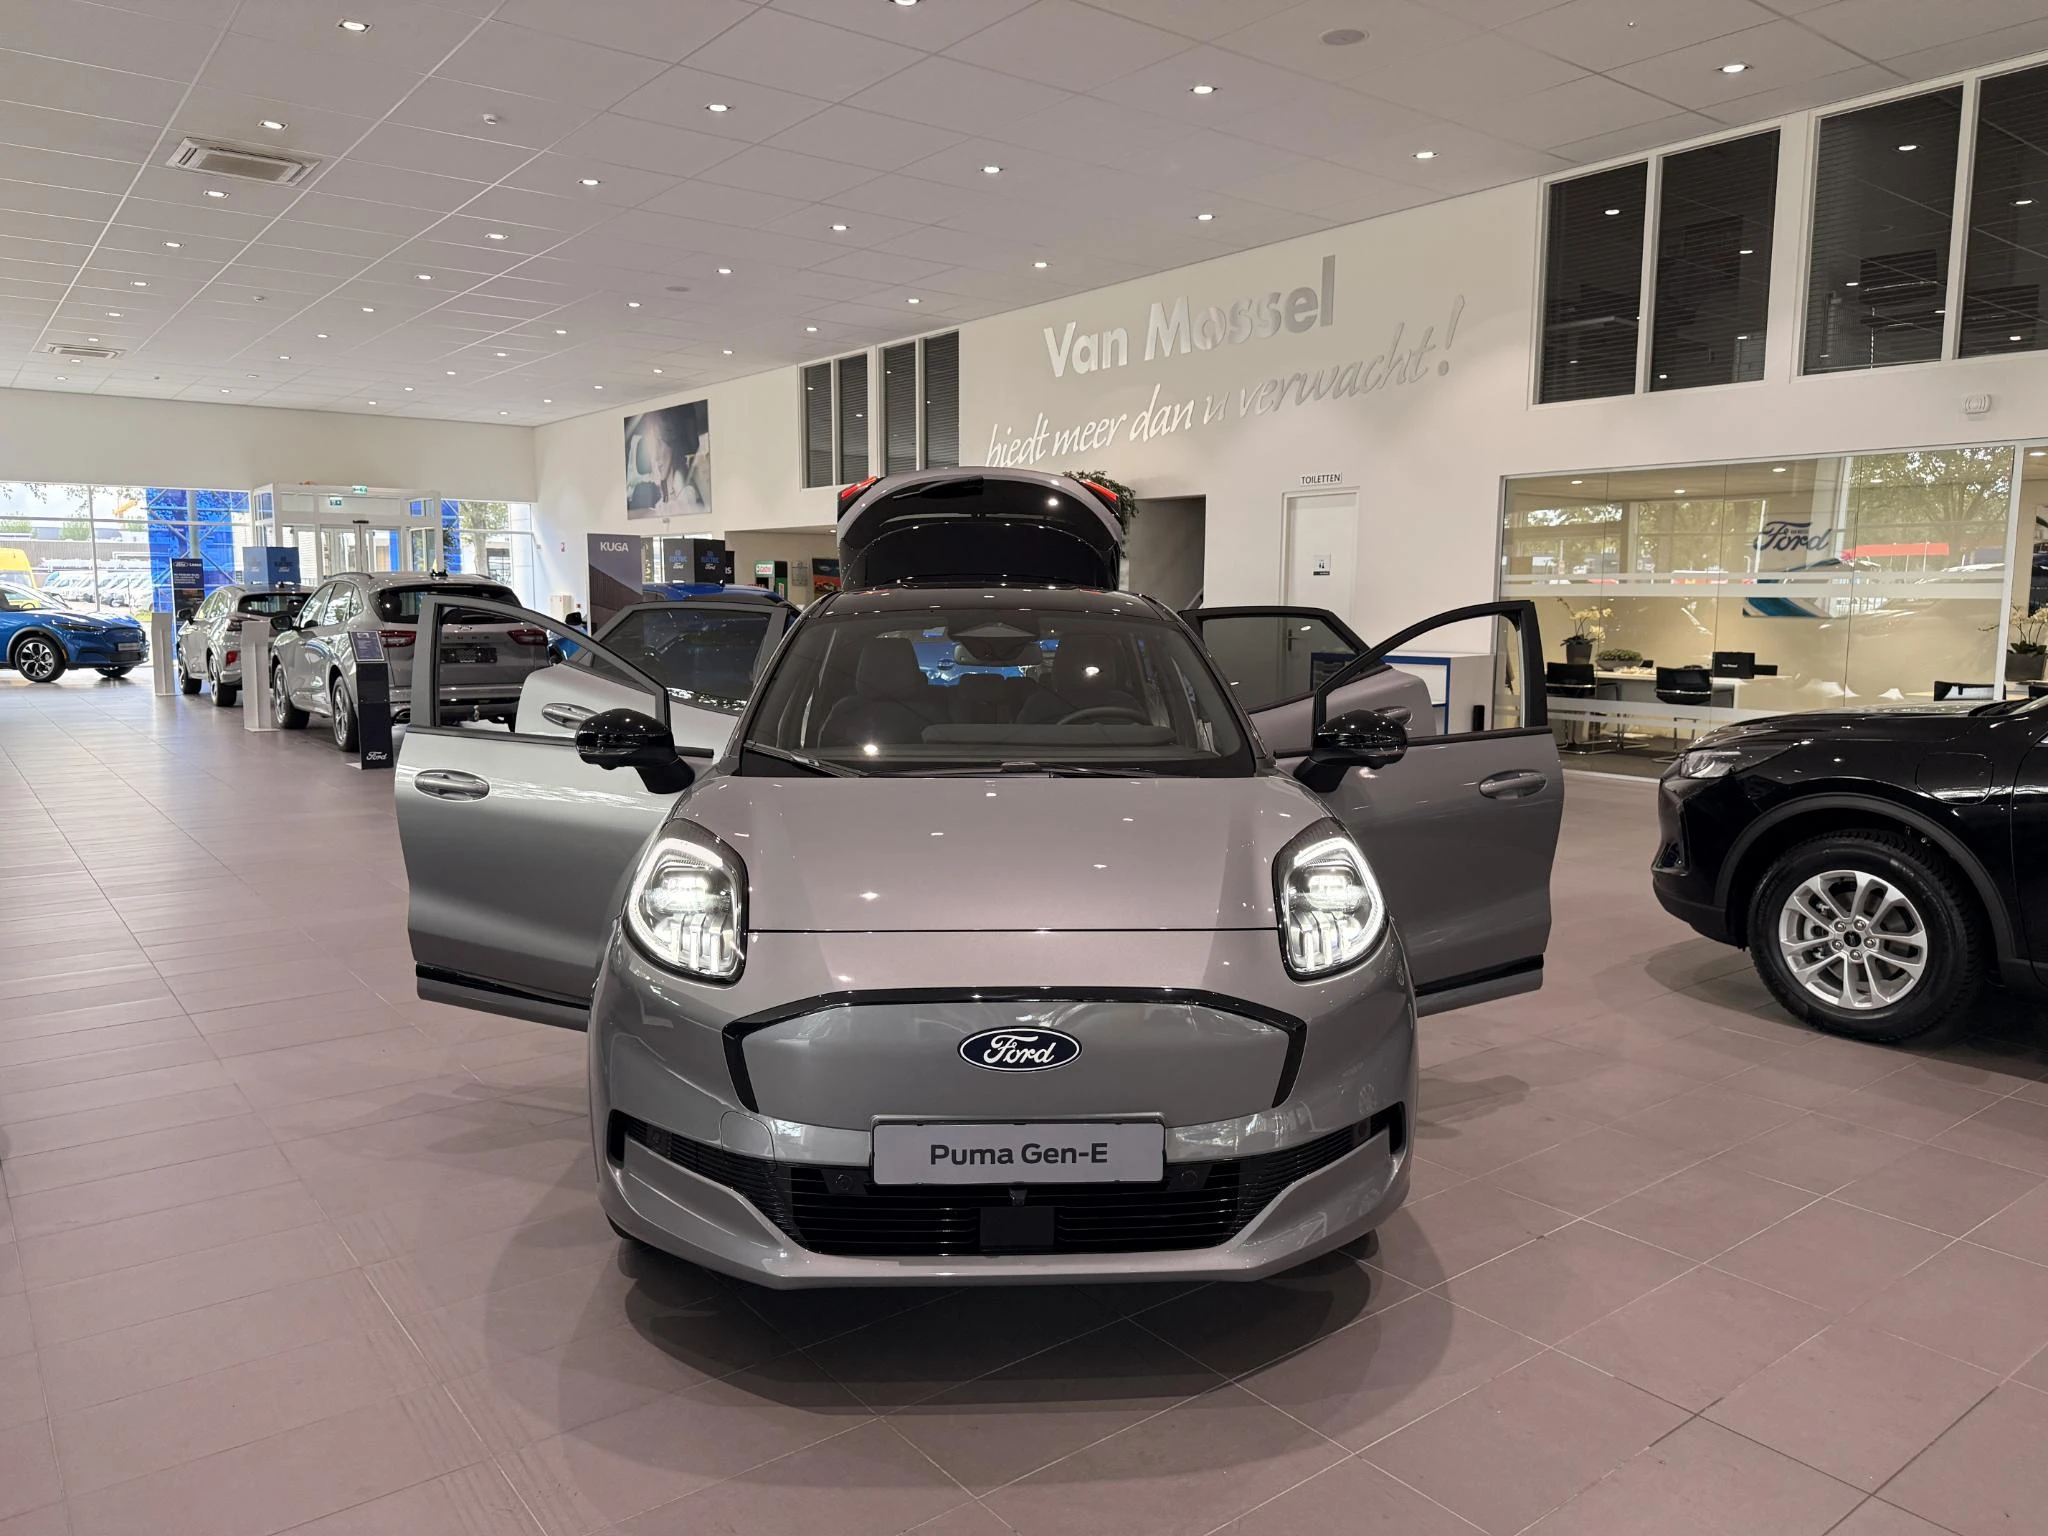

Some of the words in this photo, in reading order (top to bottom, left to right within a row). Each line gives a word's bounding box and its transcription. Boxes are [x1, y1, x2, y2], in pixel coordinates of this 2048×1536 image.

[1043, 321, 1128, 378] Van
[1144, 254, 1336, 361] Mossel
[984, 412, 1049, 467] biedt
[1052, 413, 1128, 457] meer
[1129, 383, 1195, 442] dan
[1203, 391, 1230, 424] u
[1239, 294, 1466, 418] verwacht!
[1301, 474, 1341, 484] TOILETTEN
[600, 541, 629, 552] KUGA
[1753, 520, 1832, 551] Ford
[366, 751, 387, 760] Ford
[983, 1034, 1057, 1065] Ford
[930, 1144, 1014, 1165] Puma
[1021, 1142, 1108, 1165] Gen-E
